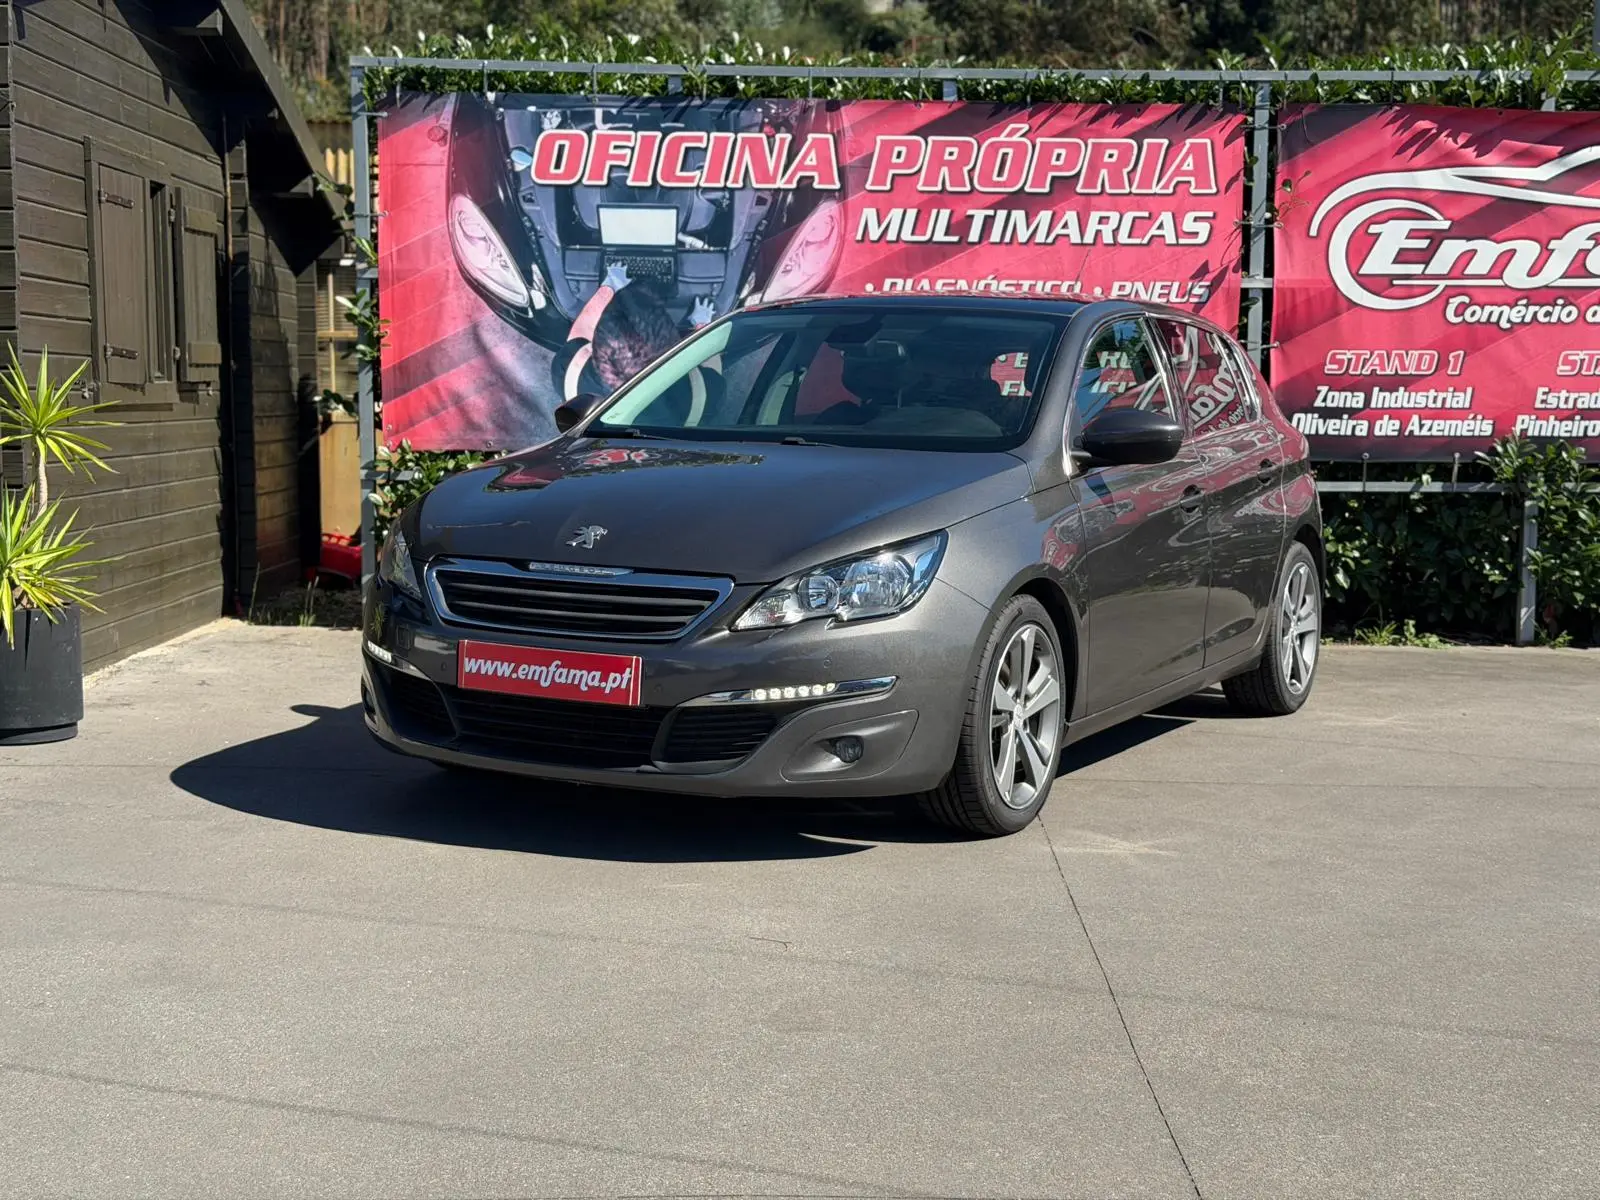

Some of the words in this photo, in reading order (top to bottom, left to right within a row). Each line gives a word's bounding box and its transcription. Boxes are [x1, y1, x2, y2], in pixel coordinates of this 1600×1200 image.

[531, 130, 840, 190] OFICINA
[865, 123, 1218, 195] PRÓPRIA
[855, 207, 1214, 247] MULTIMARCAS
[1110, 281, 1211, 304] PNEUS
[1444, 296, 1579, 329] Comércio
[1324, 350, 1440, 376] STAND
[1447, 351, 1465, 376] 1
[1556, 350, 1600, 376] ST
[1313, 385, 1366, 409] Zona
[1369, 386, 1473, 410] Industrial
[1291, 412, 1370, 437] Oliveira
[1374, 414, 1401, 437] de
[1403, 413, 1494, 438] Azeméis
[1515, 414, 1600, 437] Pinheiro
[463, 656, 632, 694] www.emfama.pt
